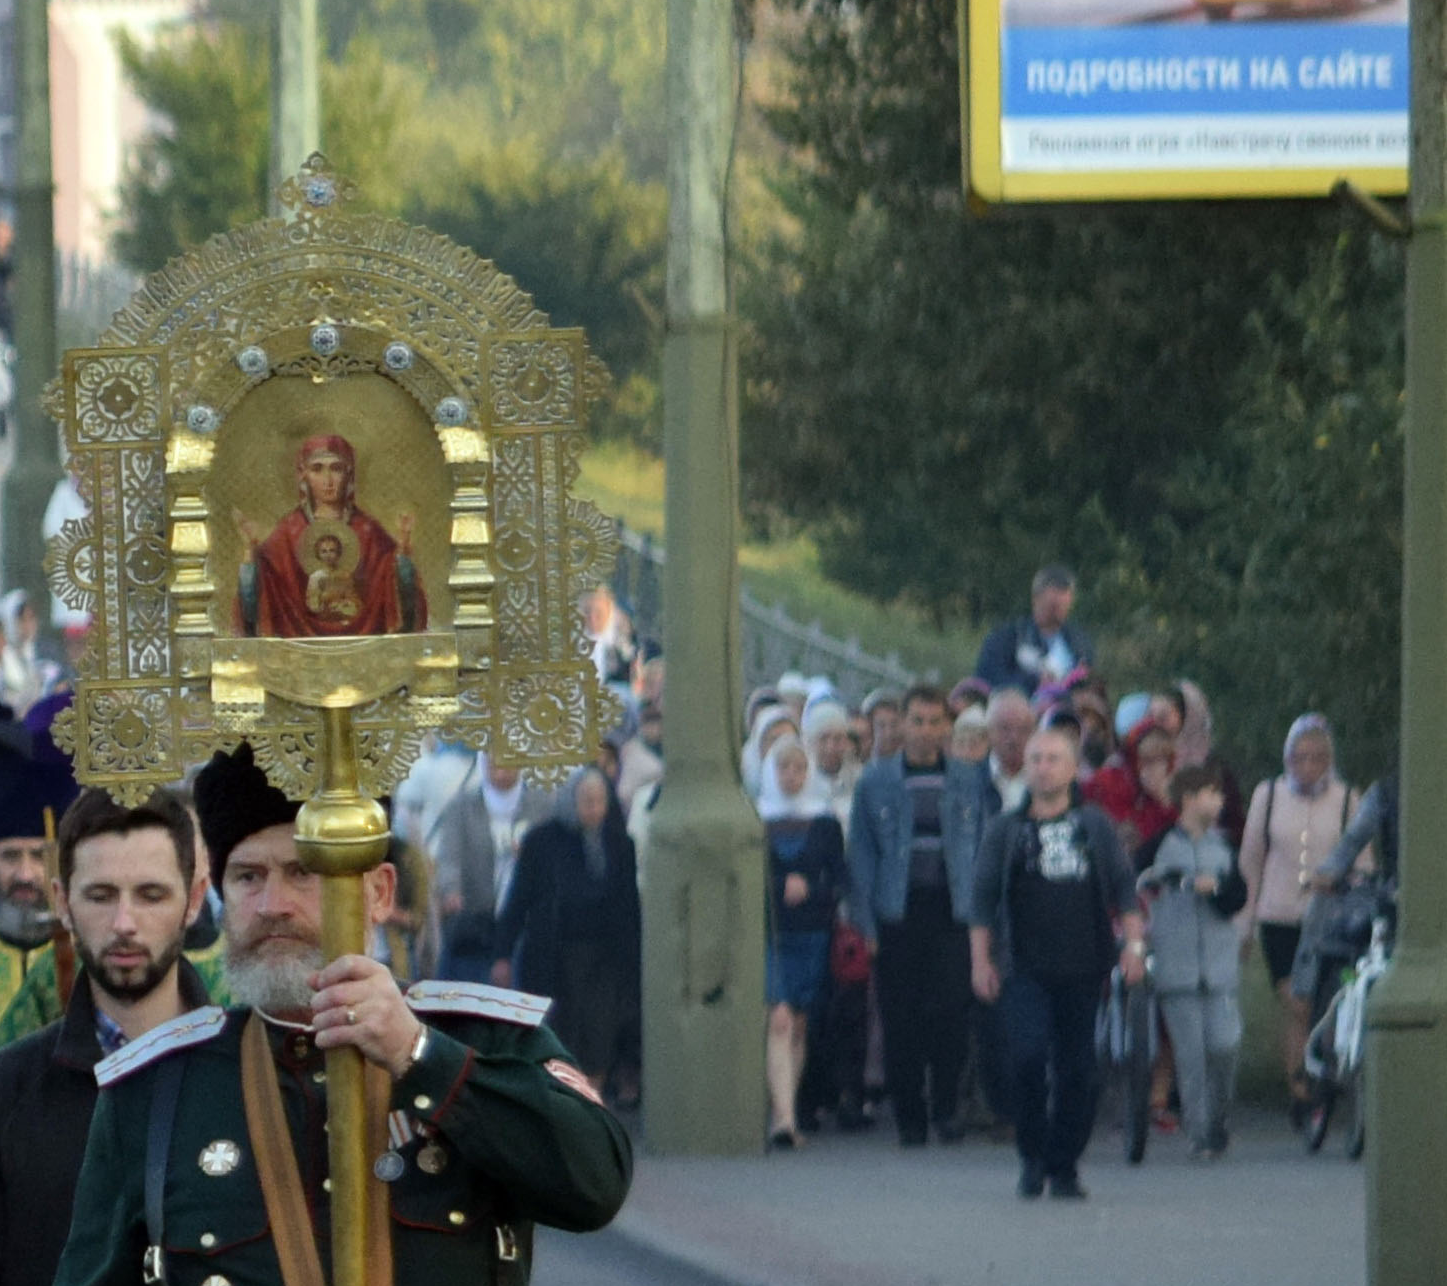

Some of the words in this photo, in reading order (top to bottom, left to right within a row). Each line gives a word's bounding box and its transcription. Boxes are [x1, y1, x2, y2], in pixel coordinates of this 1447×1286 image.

[1026, 55, 1240, 96] ПОДРОБНОСТИ
[1249, 55, 1289, 89] НА
[1298, 49, 1393, 89] САЙТЕ
